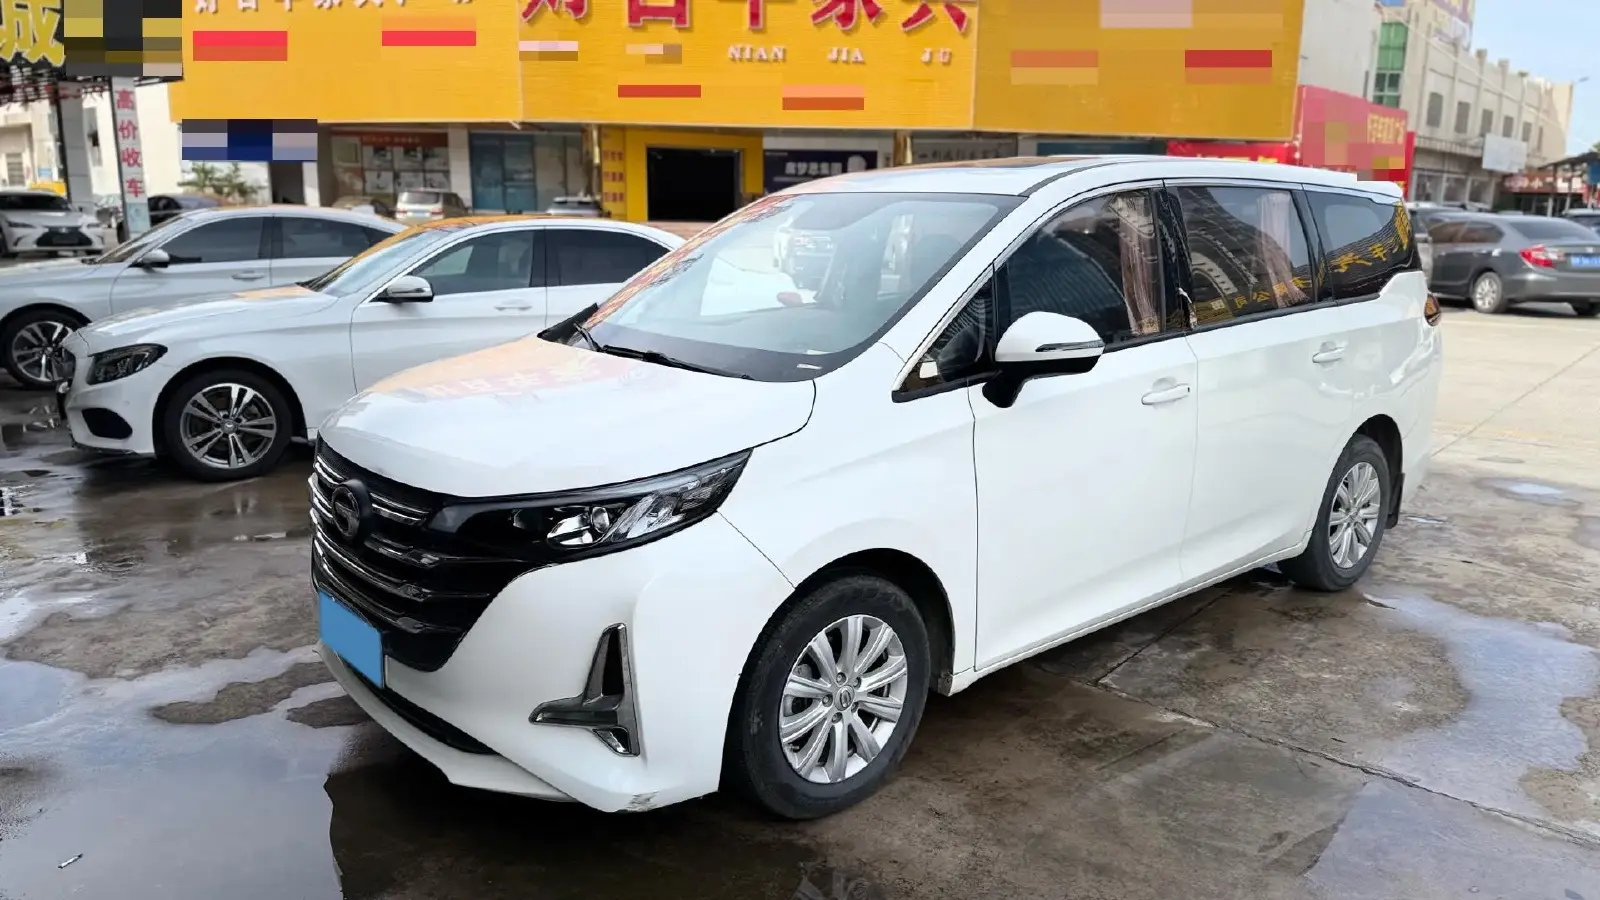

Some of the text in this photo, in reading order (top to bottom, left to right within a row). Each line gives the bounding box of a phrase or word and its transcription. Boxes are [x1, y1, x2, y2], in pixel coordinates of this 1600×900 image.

[729, 46, 785, 61] NIAN
[828, 47, 865, 63] JIA
[115, 89, 145, 198] 高价收车
